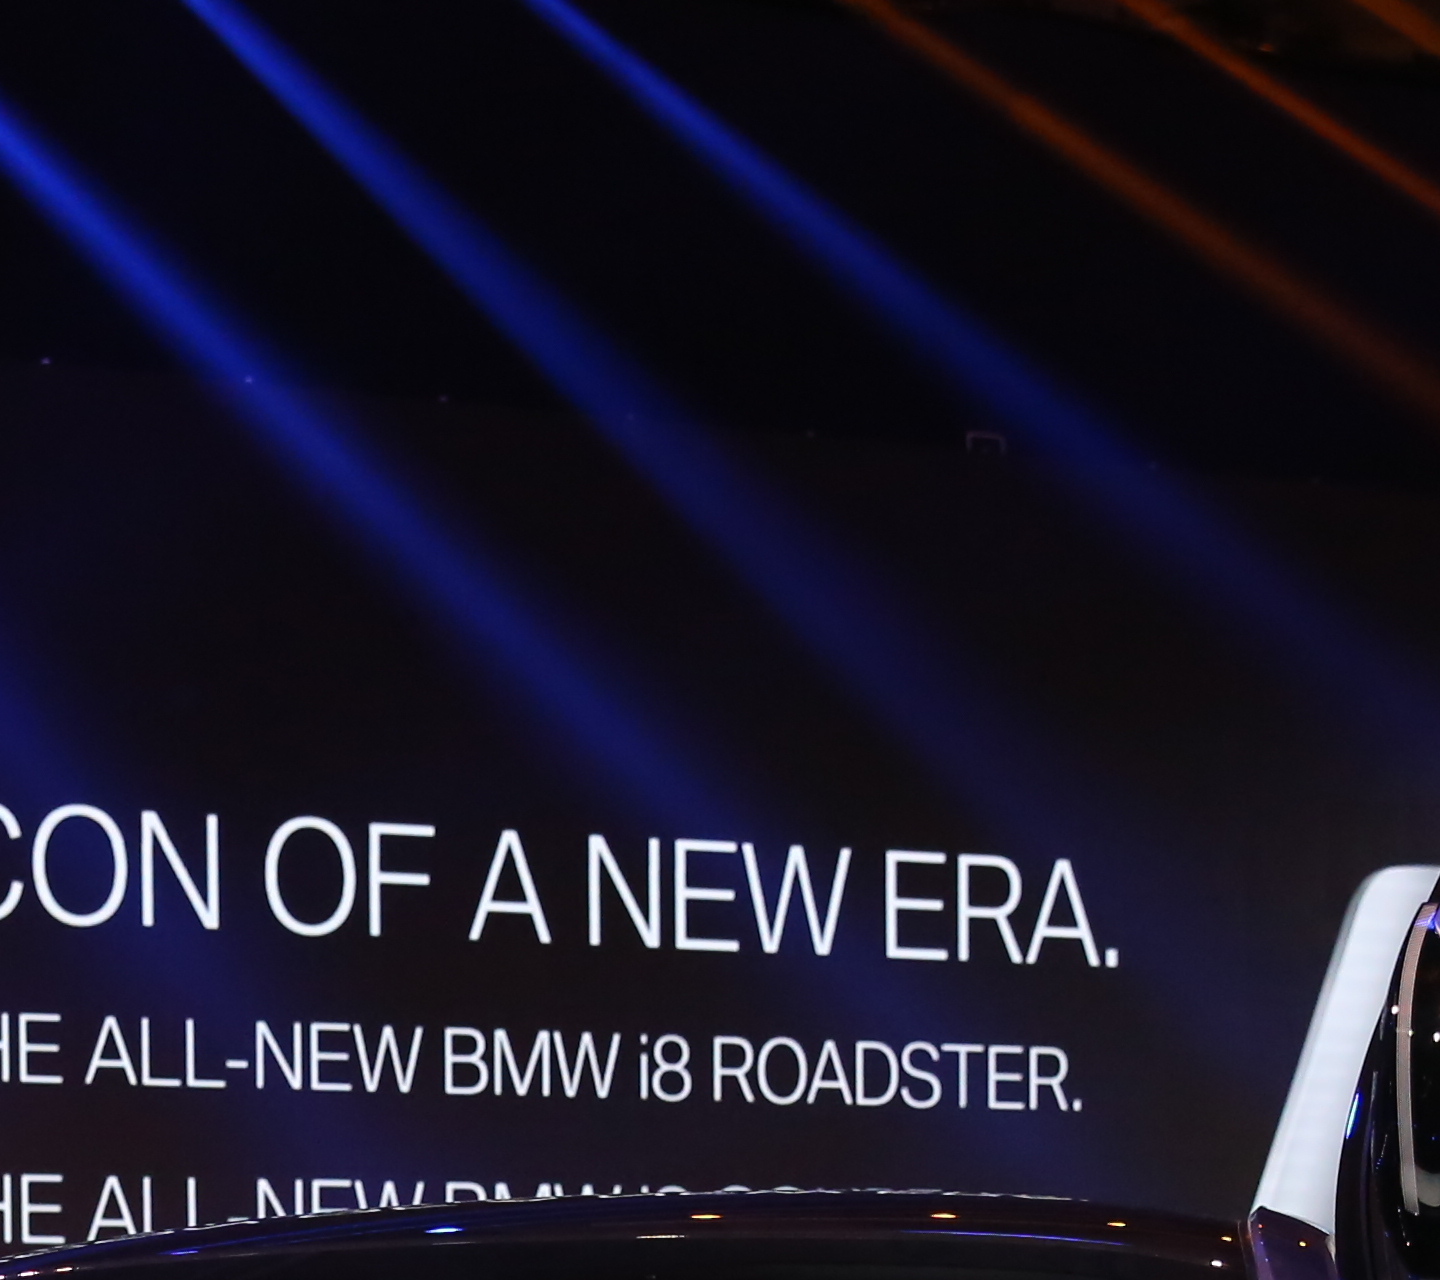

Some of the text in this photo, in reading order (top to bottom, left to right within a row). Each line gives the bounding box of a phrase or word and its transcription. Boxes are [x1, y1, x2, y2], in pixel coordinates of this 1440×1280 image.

[263, 814, 437, 938] OF
[467, 828, 553, 946] A
[587, 833, 853, 957] NEW
[884, 848, 1120, 969] ERA.
[83, 1014, 425, 1095] ALL-NEW
[443, 1025, 622, 1100] BMW
[638, 1033, 693, 1104] i8
[712, 1034, 1083, 1113] ROADSTER.
